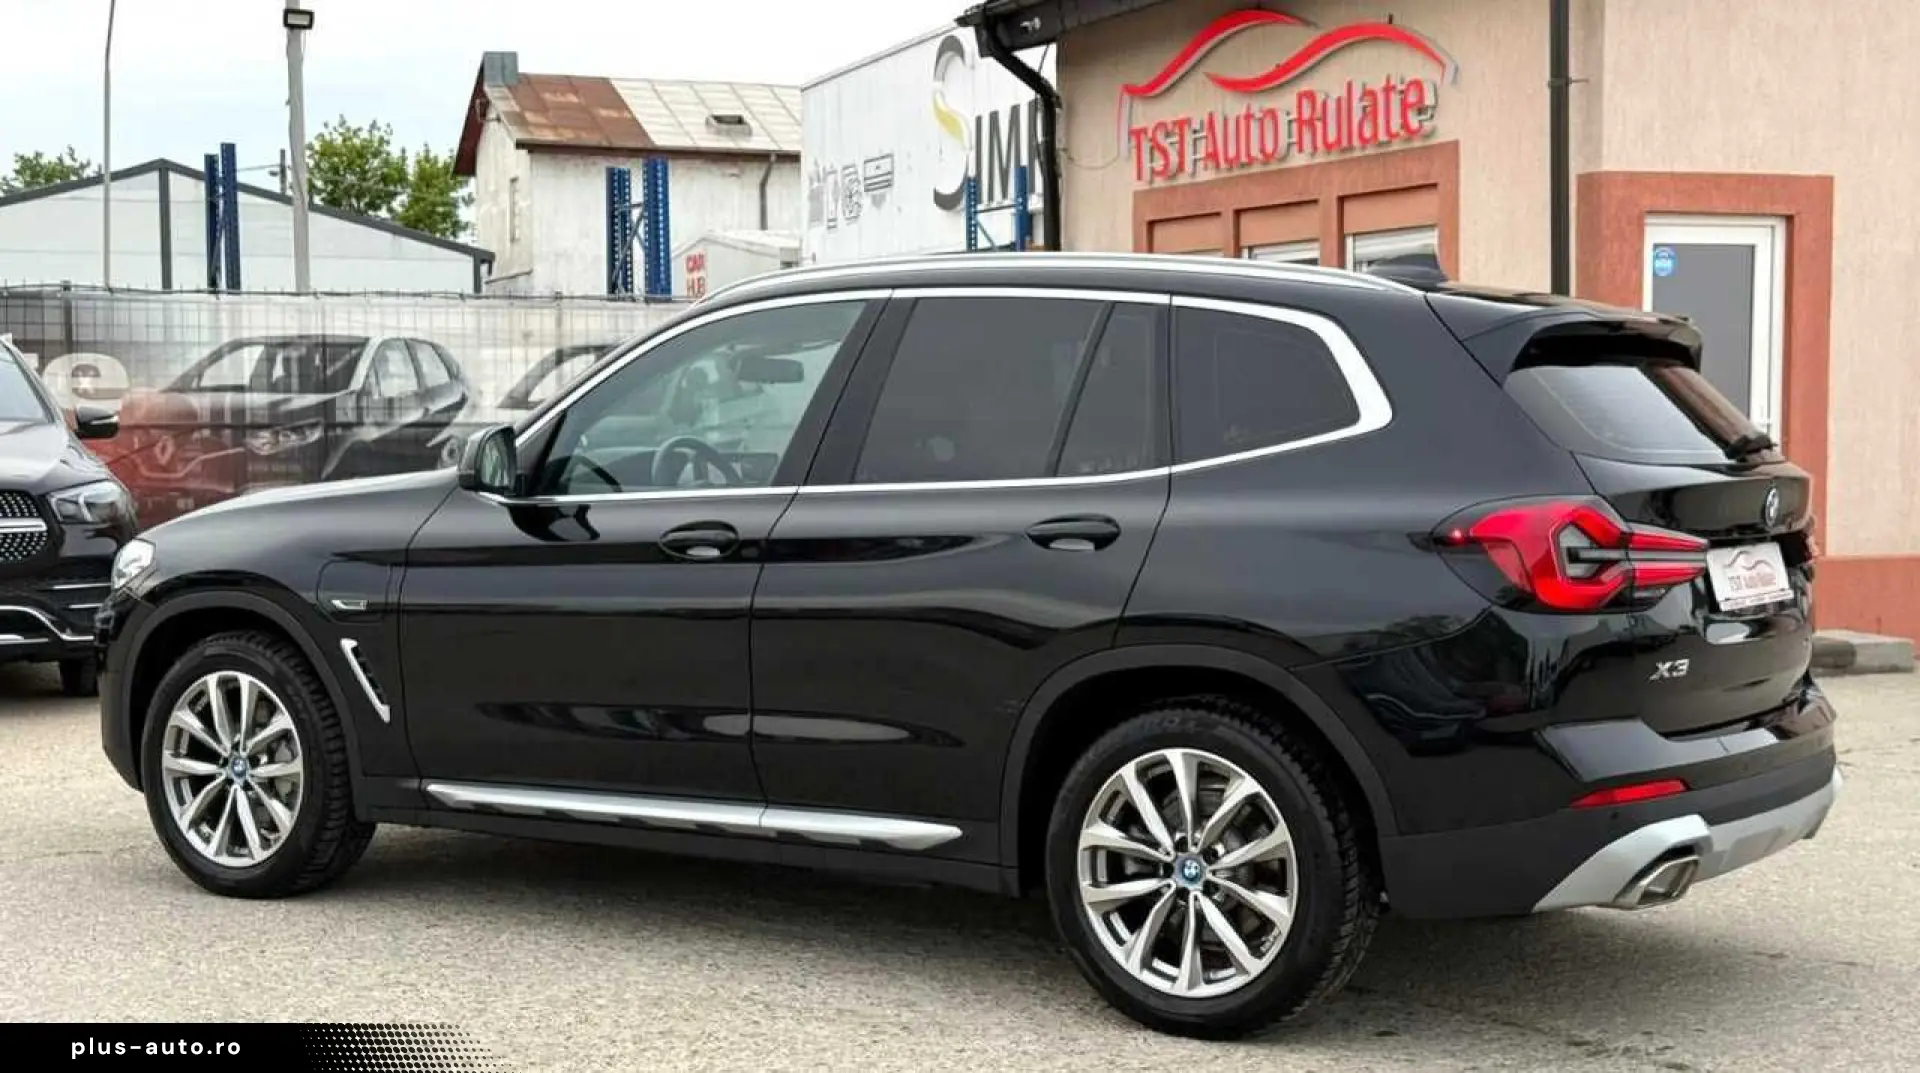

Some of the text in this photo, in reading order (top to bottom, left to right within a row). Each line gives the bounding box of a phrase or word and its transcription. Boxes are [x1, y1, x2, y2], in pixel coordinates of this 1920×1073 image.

[1130, 74, 1426, 181] TST Auto Rulate
[1649, 659, 1690, 680] X3
